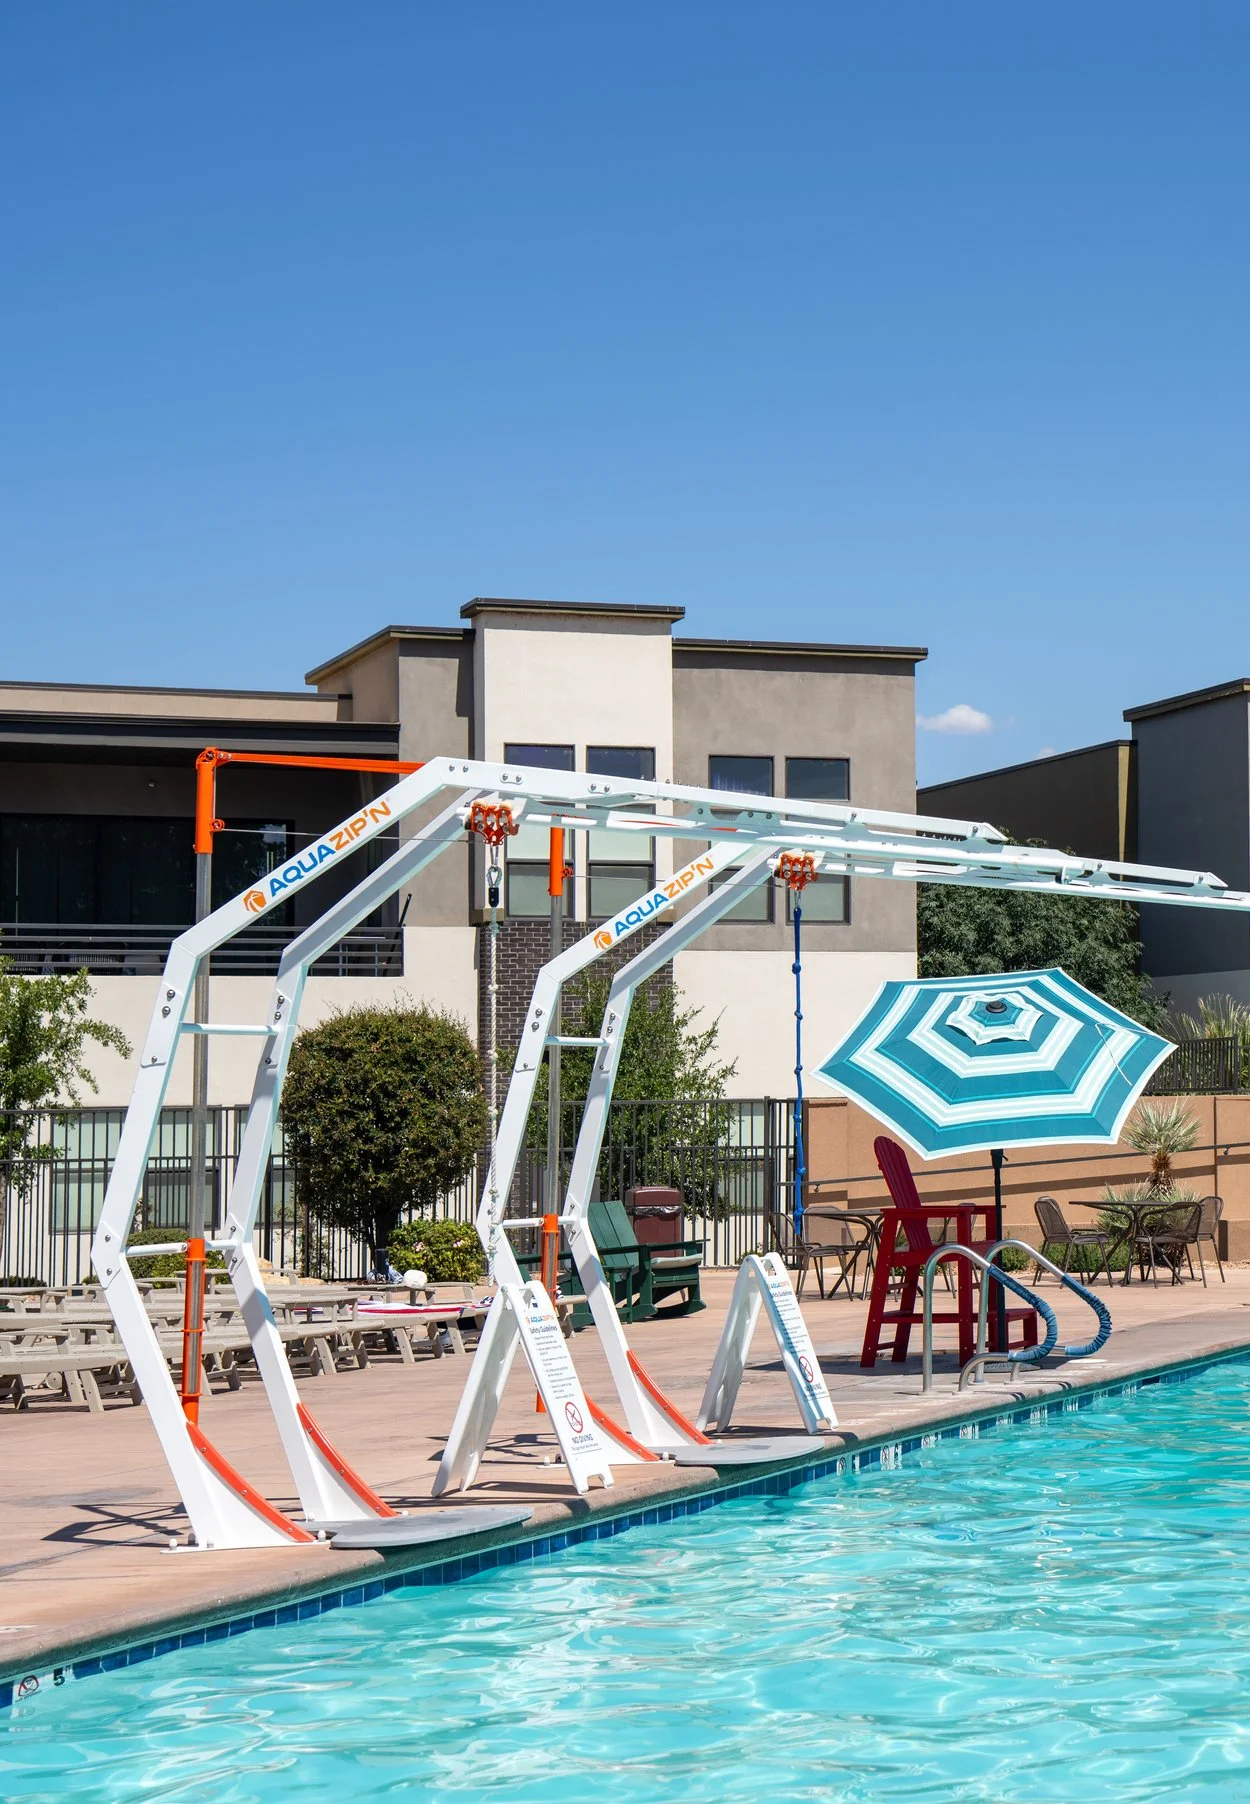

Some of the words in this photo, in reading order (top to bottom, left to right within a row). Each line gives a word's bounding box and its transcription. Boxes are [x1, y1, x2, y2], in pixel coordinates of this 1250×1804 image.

[269, 800, 392, 898] AQUAZIP'N
[614, 857, 714, 937] AQUAZIP'N
[540, 1325, 558, 1334] Guidelines
[579, 1433, 594, 1443] DIVING
[53, 1667, 66, 1687] 5
